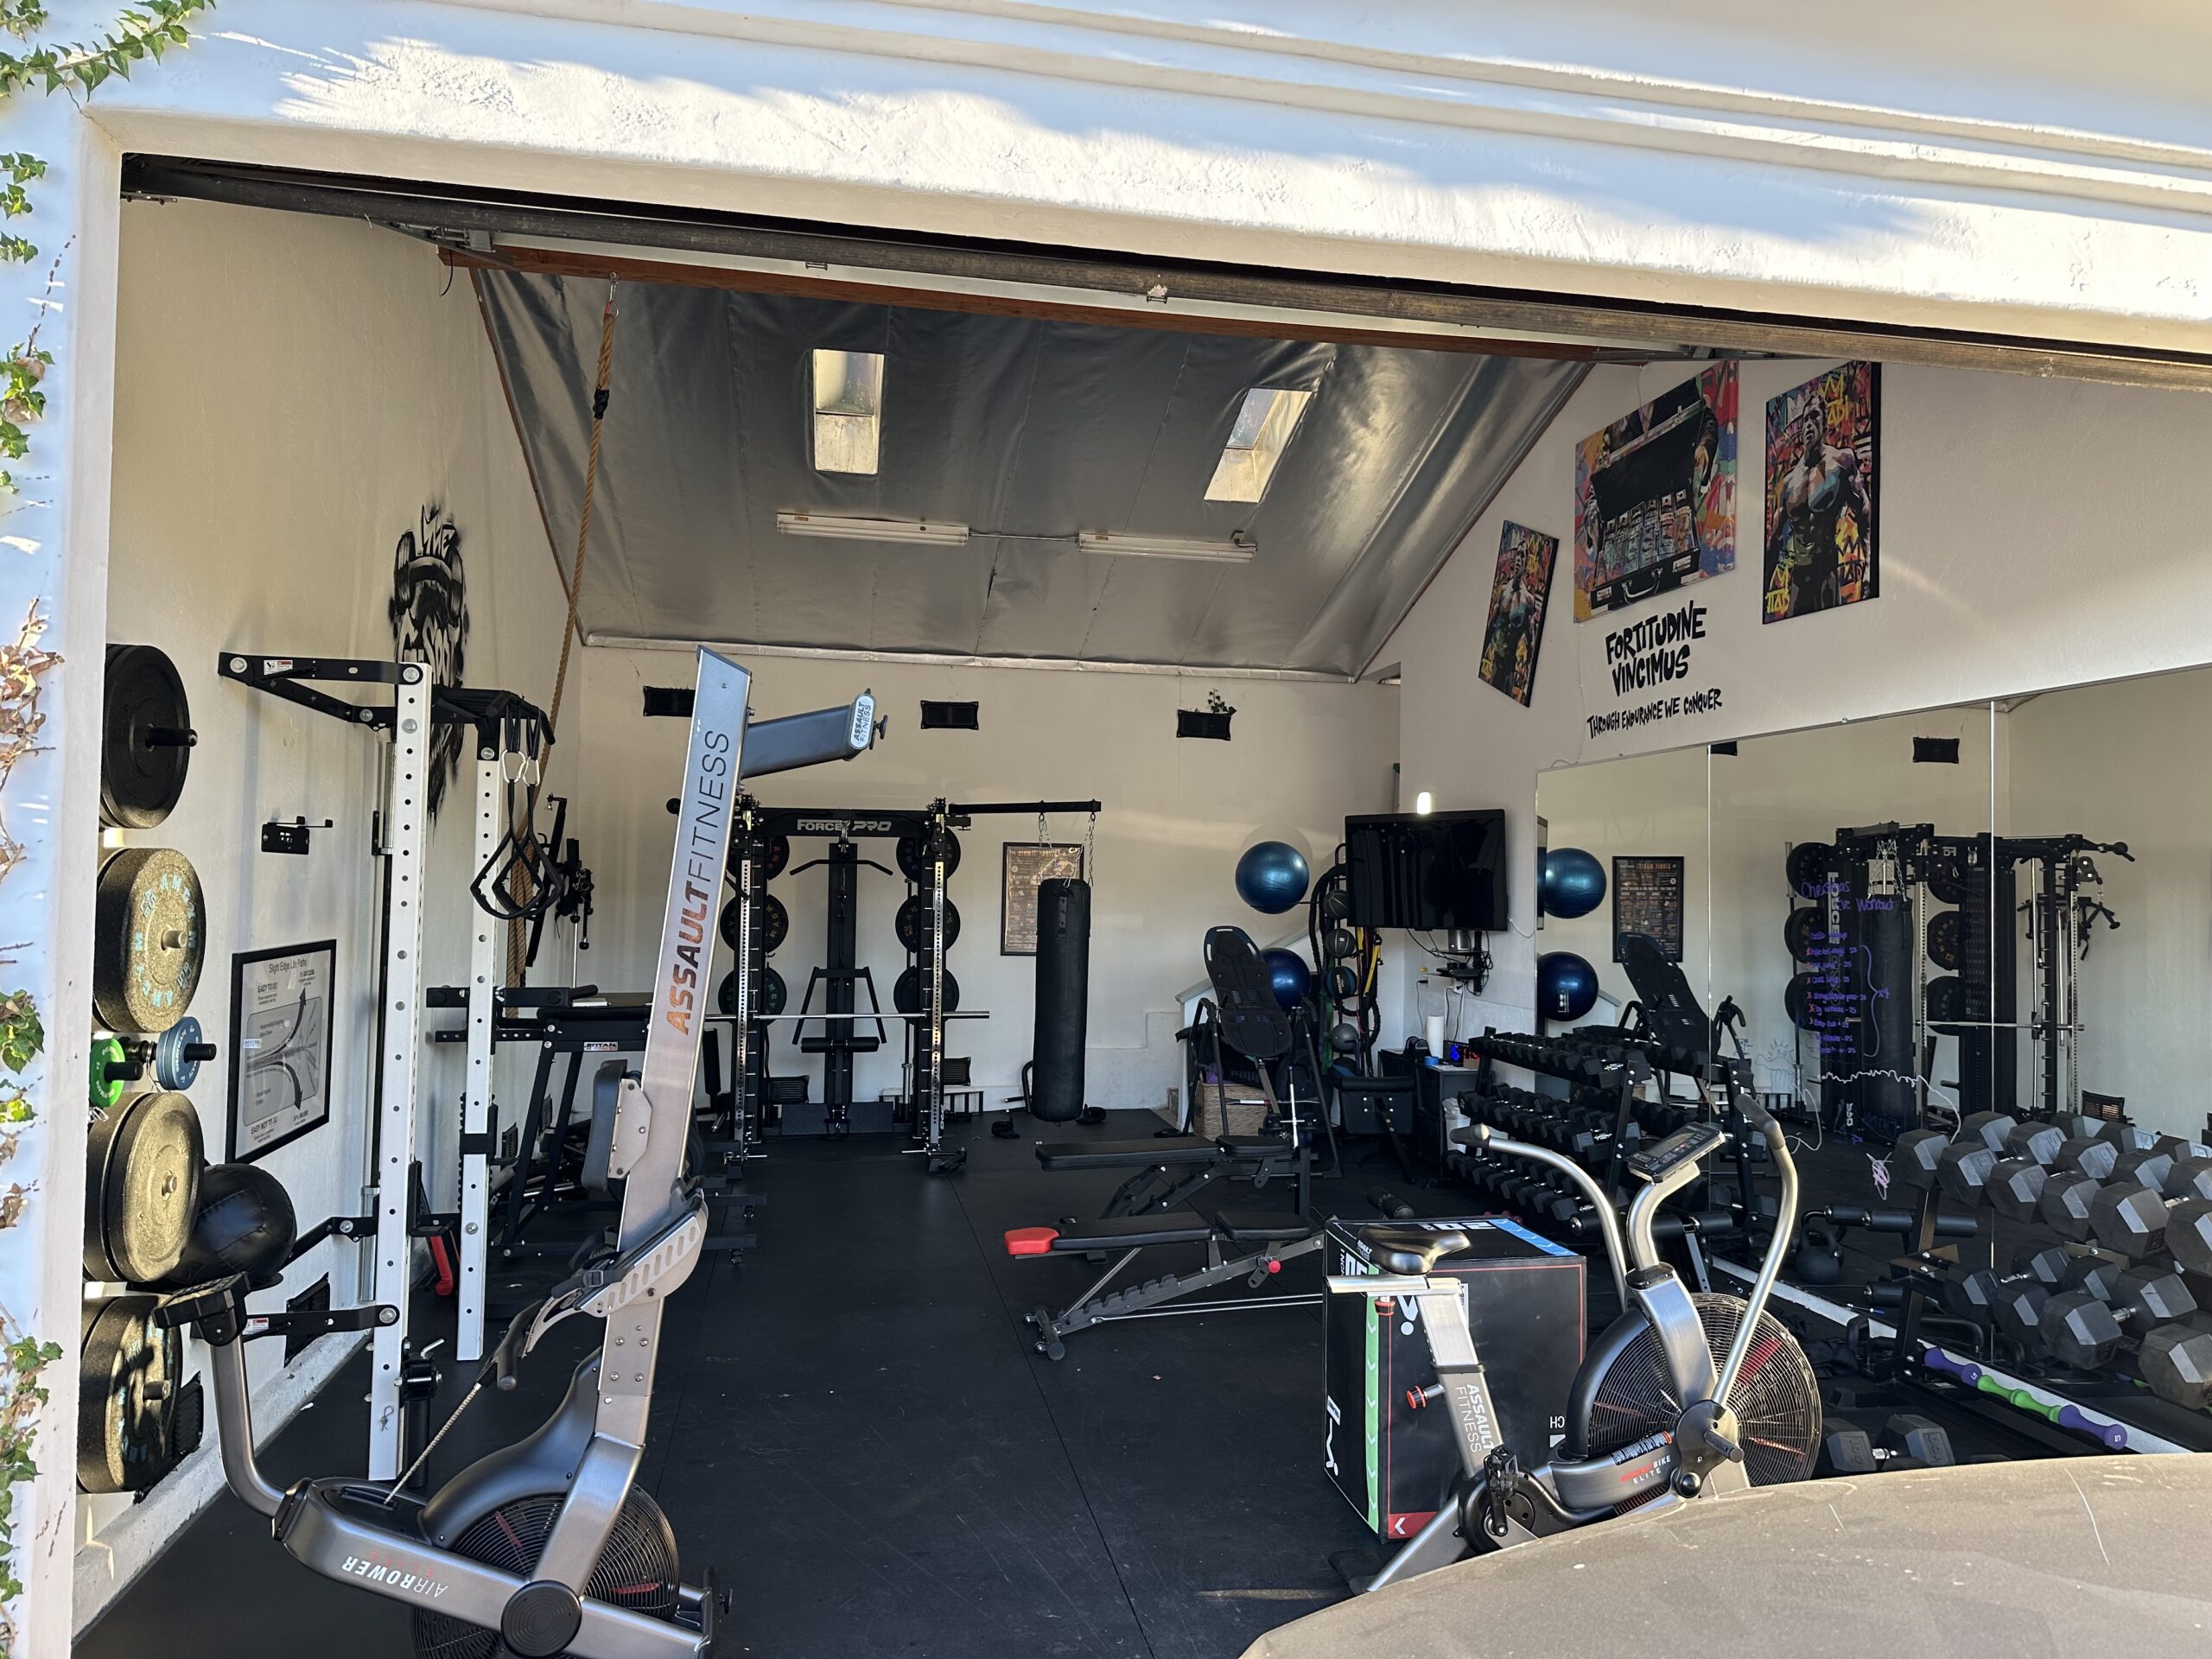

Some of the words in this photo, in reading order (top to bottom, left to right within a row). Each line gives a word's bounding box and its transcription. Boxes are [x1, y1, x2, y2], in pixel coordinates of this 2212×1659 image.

[1605, 600, 1707, 665] FORTITUDINE
[1612, 644, 1691, 697] VINCIMUS
[854, 701, 865, 741] ASSAULT
[860, 704, 871, 742] FITNESS
[1587, 711, 1620, 739] THROUGH
[1622, 700, 1663, 731] ENDURANCE
[1665, 696, 1681, 718] WE
[1684, 688, 1723, 715] CONQUER
[797, 819, 843, 831] FORCE
[269, 963, 280, 975] Slight
[280, 961, 290, 973] Edge
[298, 958, 308, 968] Paths
[1454, 1386, 1482, 1453] FITNESS
[1467, 1383, 1495, 1450] ASSAULT
[2114, 1434, 2121, 1443] 5
[1632, 1467, 1662, 1485] ELITE
